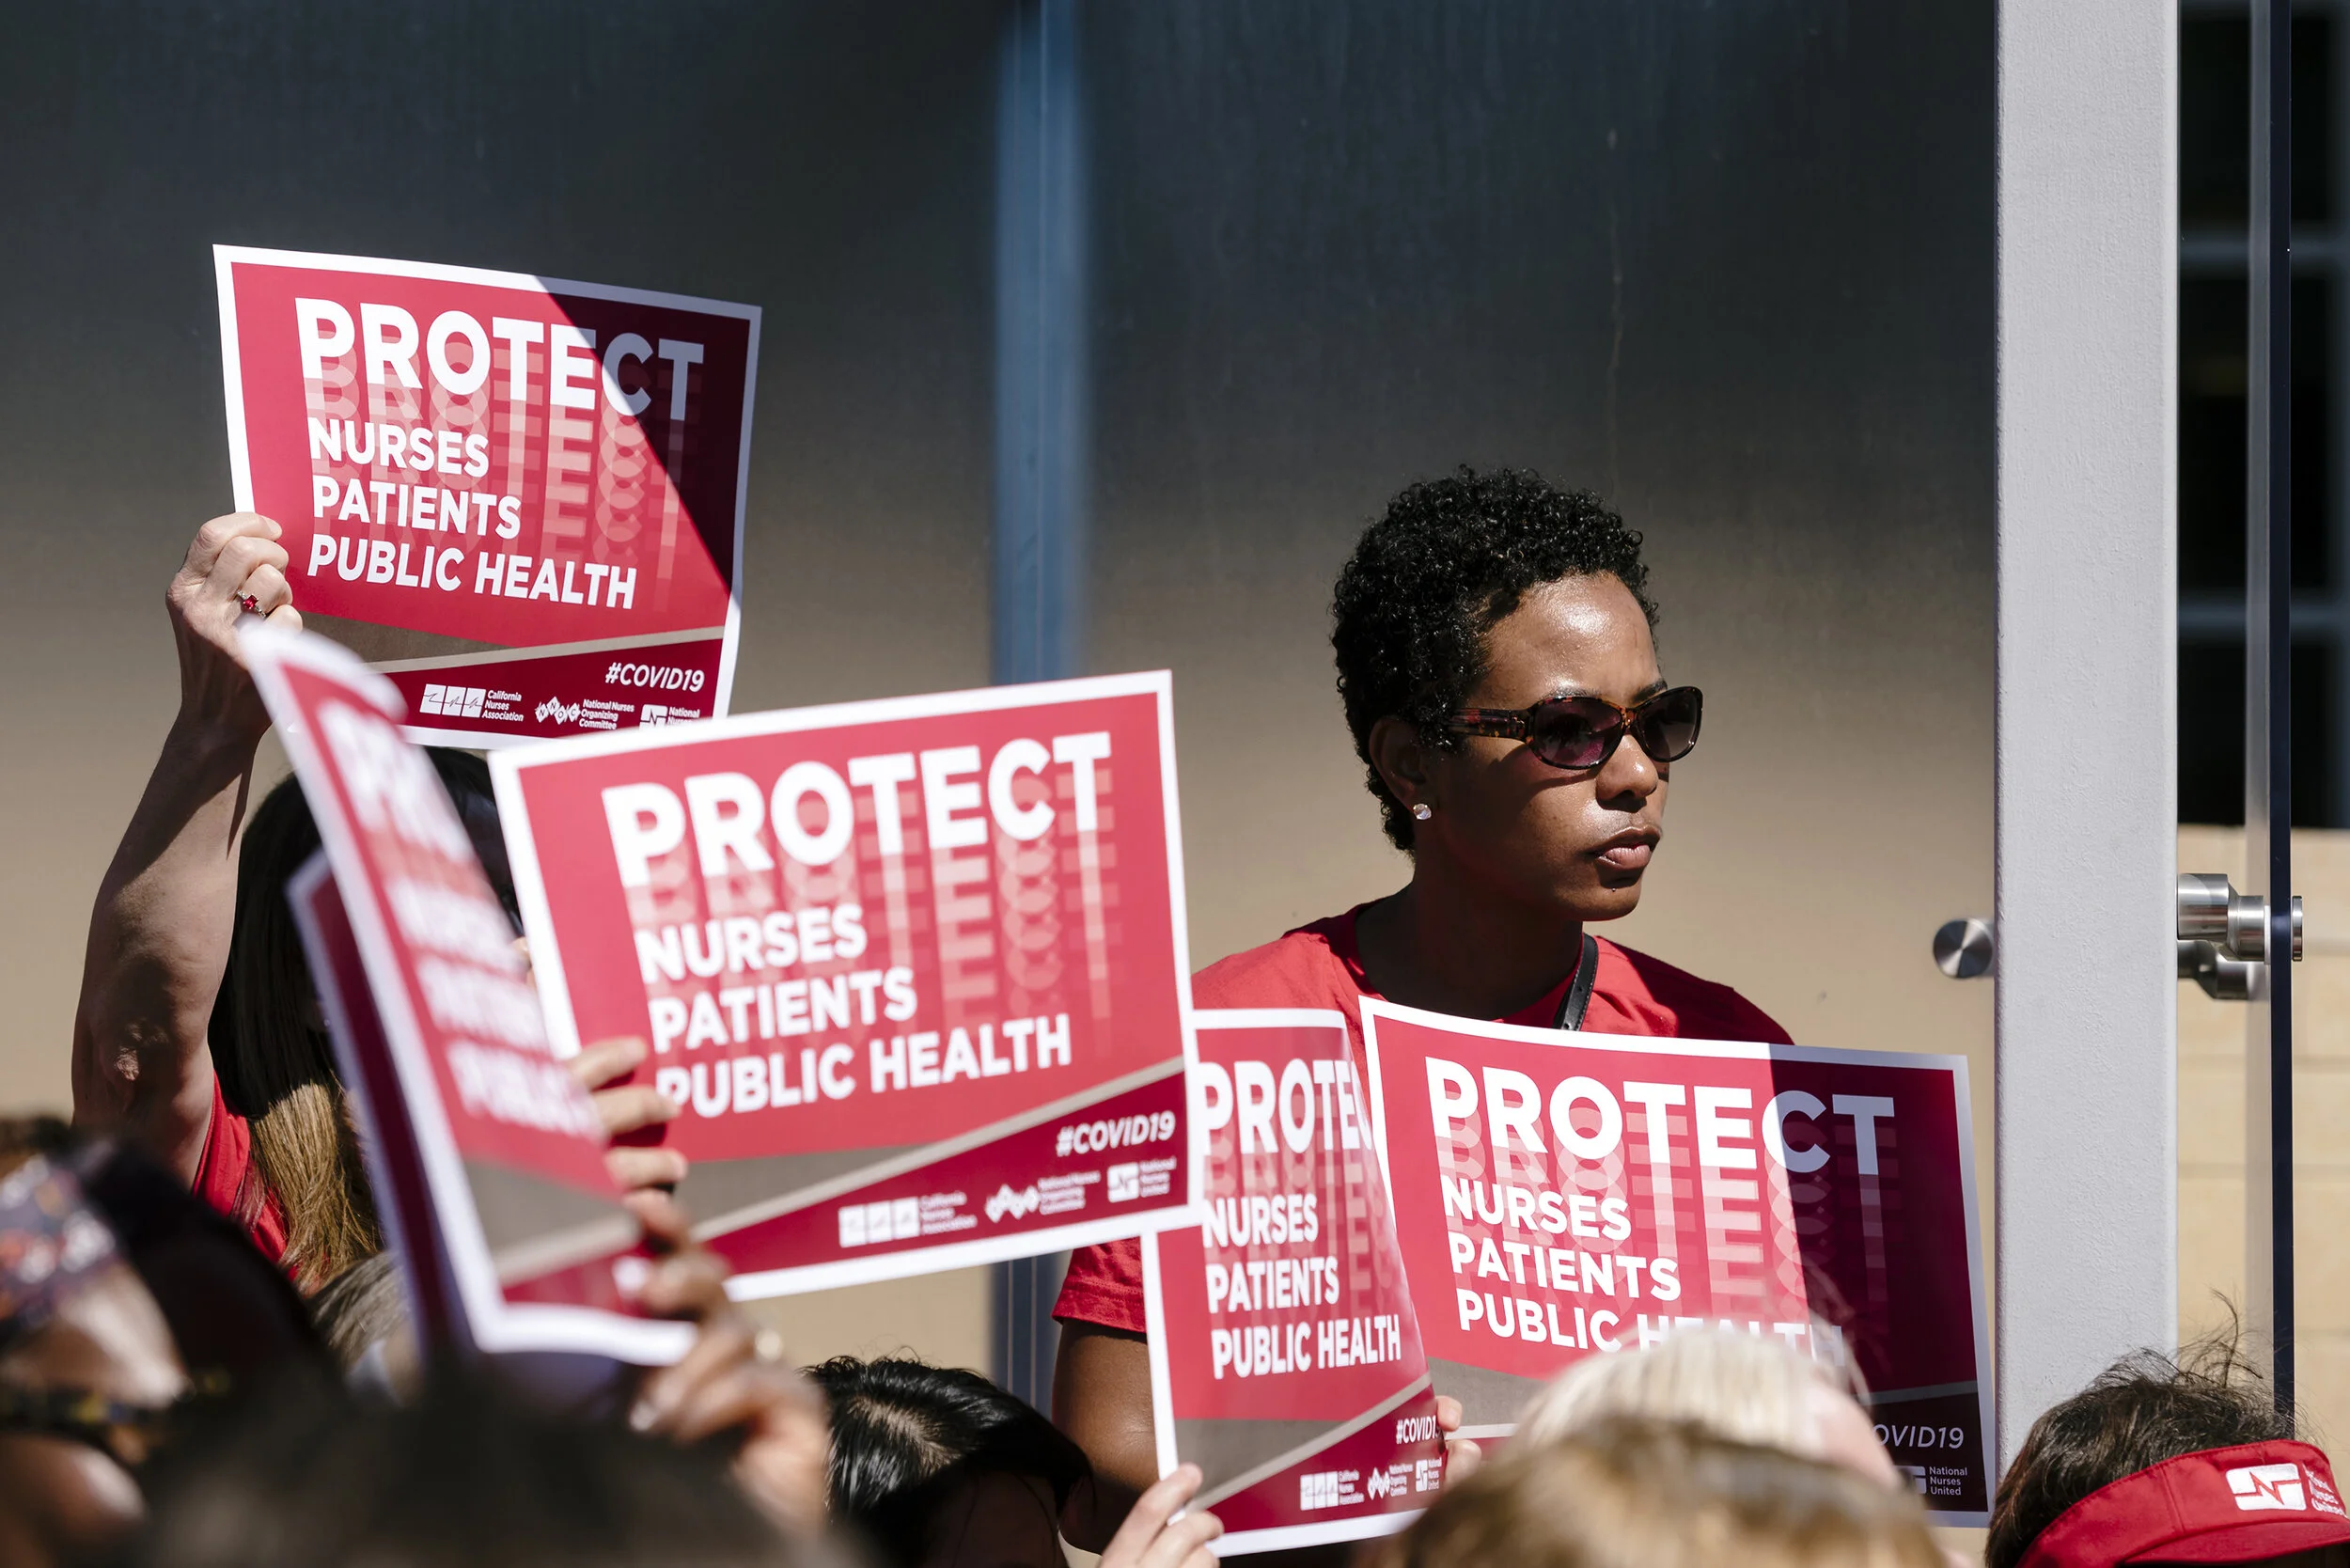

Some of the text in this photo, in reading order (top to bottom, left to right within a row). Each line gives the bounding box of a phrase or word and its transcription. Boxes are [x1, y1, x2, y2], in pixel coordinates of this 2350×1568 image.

[295, 297, 704, 421] PROTECT
[309, 417, 489, 478] NURSES
[313, 475, 521, 540] PATIENTS
[307, 535, 637, 609] PUBLIC HEALTH
[484, 700, 509, 711] Nurses
[487, 690, 522, 701] California
[605, 662, 705, 693] #COVID19
[481, 711, 525, 722] Association
[580, 710, 619, 722] Organizing
[583, 699, 634, 713] National Nurses
[668, 707, 700, 718] National
[602, 732, 1111, 888] PROTECT
[632, 903, 868, 984] NURSES
[647, 966, 918, 1054] PATIENTS
[655, 1043, 856, 1119] PUBLIC
[870, 1012, 1073, 1094] HEALTH
[1056, 1110, 1176, 1158] #COVID19
[1424, 1056, 1895, 1175] PROTECT
[1201, 1193, 1319, 1248] NURSES
[1441, 1175, 1632, 1242] NURSES
[1205, 1256, 1340, 1313] PATIENTS
[1449, 1234, 1682, 1303] PATIENTS
[1211, 1313, 1402, 1380] PUBLIC HEALTH
[1456, 1287, 1622, 1353] PUBLIC
[1396, 1415, 1439, 1445] #COVID1
[1872, 1423, 1965, 1449] OVID19
[1929, 1466, 1967, 1476] National
[1930, 1477, 1962, 1485] Nurses
[1930, 1486, 1962, 1496] United
